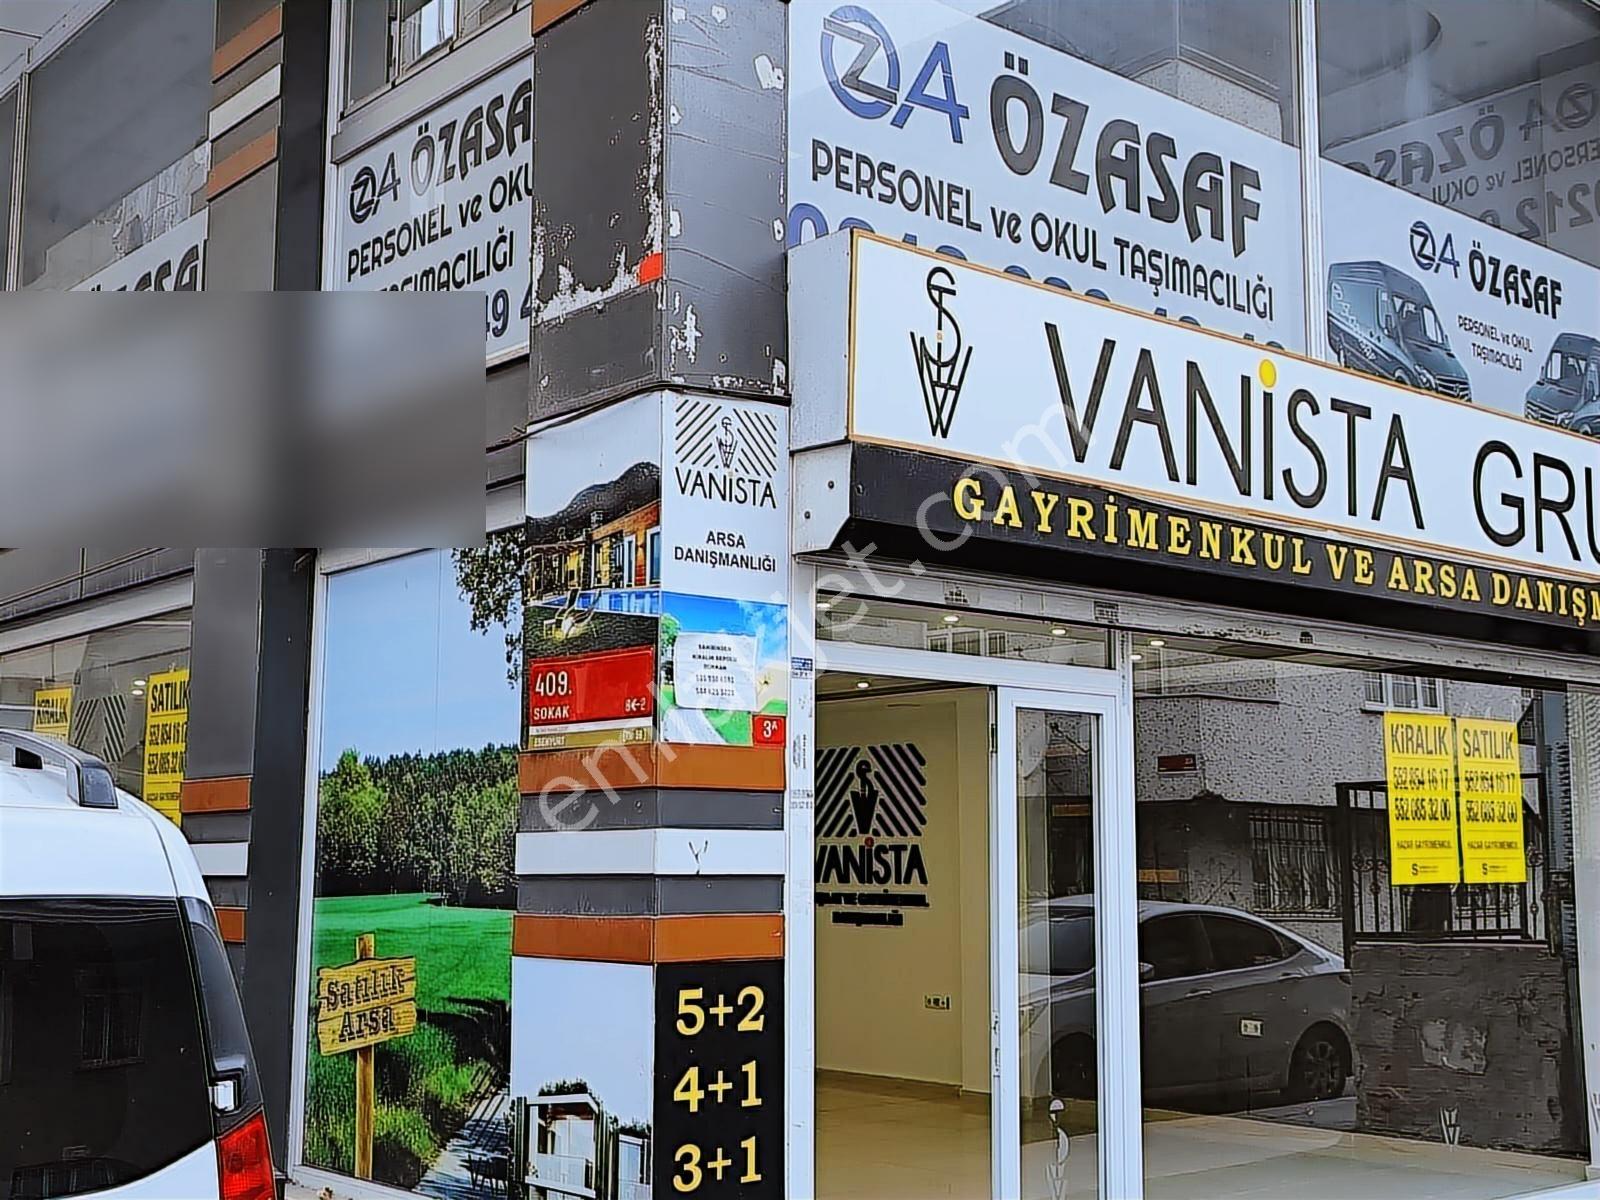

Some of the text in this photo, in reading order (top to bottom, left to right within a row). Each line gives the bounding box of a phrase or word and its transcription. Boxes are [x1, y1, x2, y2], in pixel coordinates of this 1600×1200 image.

[990, 51, 1262, 258] ÖZASAF
[348, 204, 453, 283] PERSONEL
[459, 194, 482, 228] ve
[812, 139, 983, 232] PERSONEL
[990, 206, 1022, 244] ve
[1031, 213, 1107, 270] OKUL
[1113, 235, 1274, 323] TAŞIMACILIĞI
[381, 225, 514, 291] IMACILIĞI
[1469, 240, 1563, 320] ÖZASAF
[486, 288, 510, 339] 9
[1458, 314, 1500, 342] PERSONEL
[1511, 334, 1533, 353] OKUL
[1044, 321, 1426, 531] VANİSTA
[675, 467, 777, 509] VANİSTA
[673, 545, 777, 573] DANIŞMANLIĞI
[706, 530, 745, 550] ARSA
[953, 477, 1312, 577] GAYRİMENKUL
[1327, 543, 1374, 587] VE
[1386, 556, 1481, 603] ARSA
[150, 680, 190, 713] SATILIK
[535, 671, 572, 697] 409.
[533, 705, 569, 720] SOKAK
[1390, 723, 1449, 756] KİRALIK
[1463, 728, 1514, 759] SATILIK
[326, 966, 407, 1011] Satılık
[675, 985, 766, 1036] 5+2
[338, 1007, 397, 1043] Arsa
[672, 1060, 763, 1113] 4+1
[672, 1135, 763, 1192] 3+1
